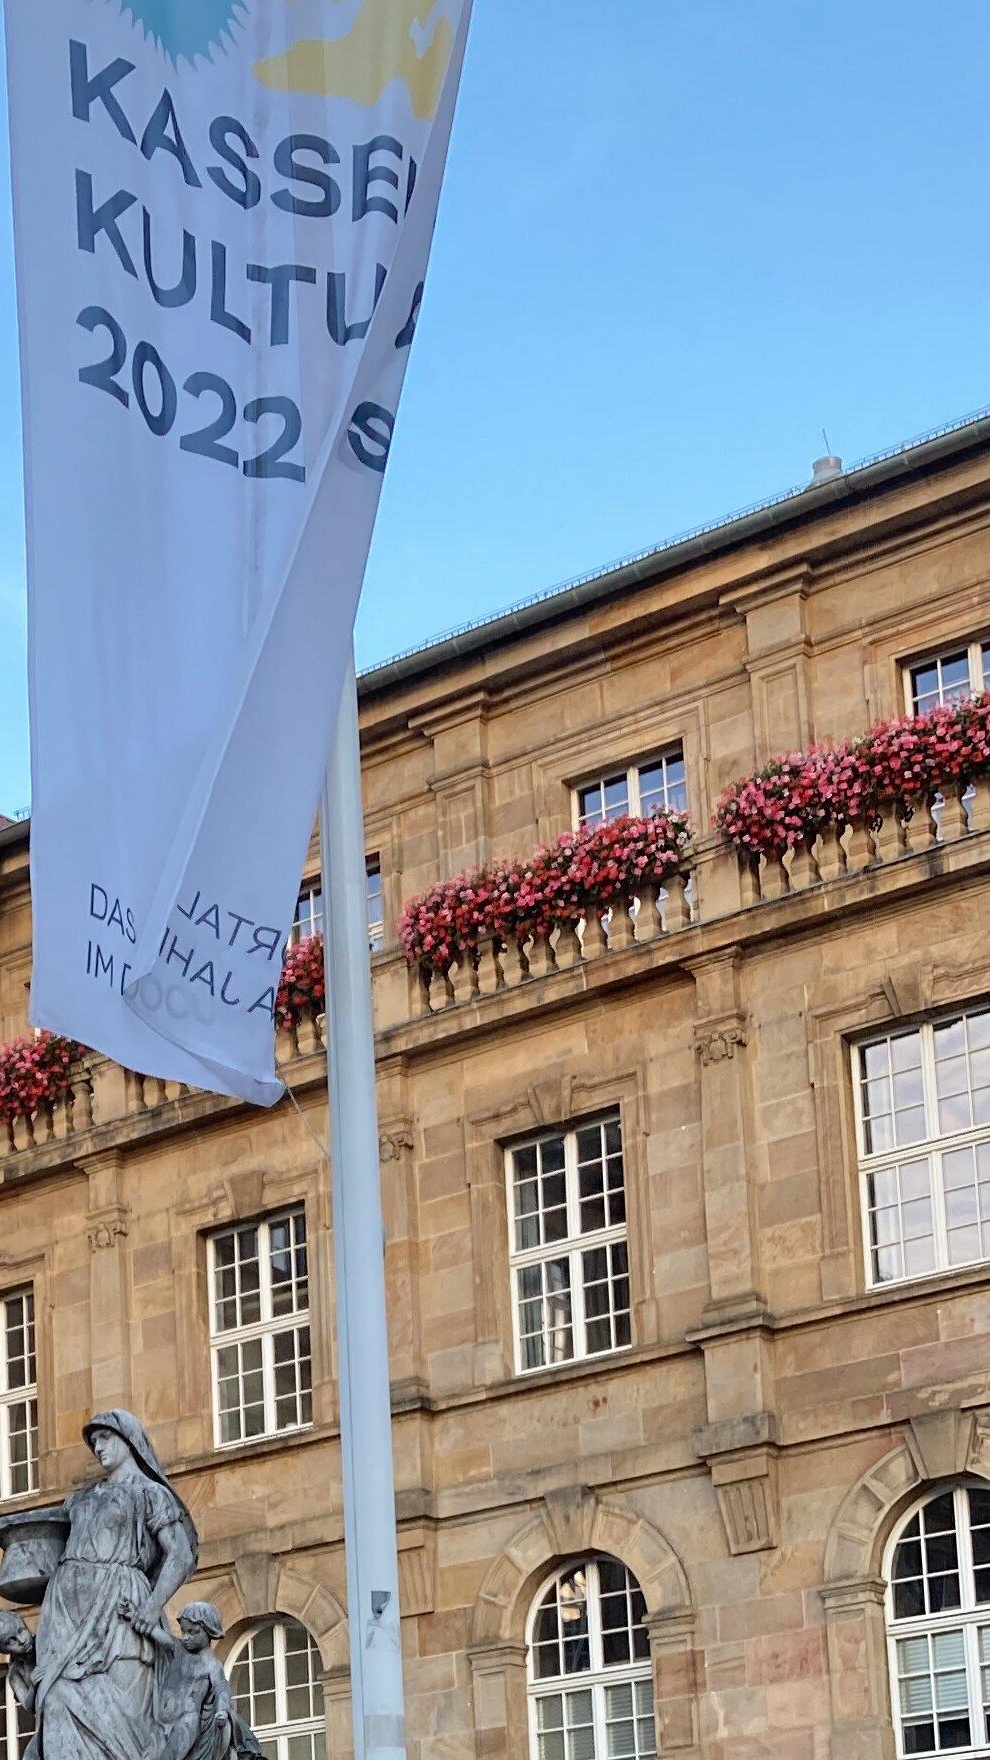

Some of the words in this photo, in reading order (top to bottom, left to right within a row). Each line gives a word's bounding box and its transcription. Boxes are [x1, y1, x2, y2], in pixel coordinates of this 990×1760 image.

[74, 167, 388, 347] KULTU
[89, 883, 137, 945] DAS
[86, 940, 114, 989] IM
